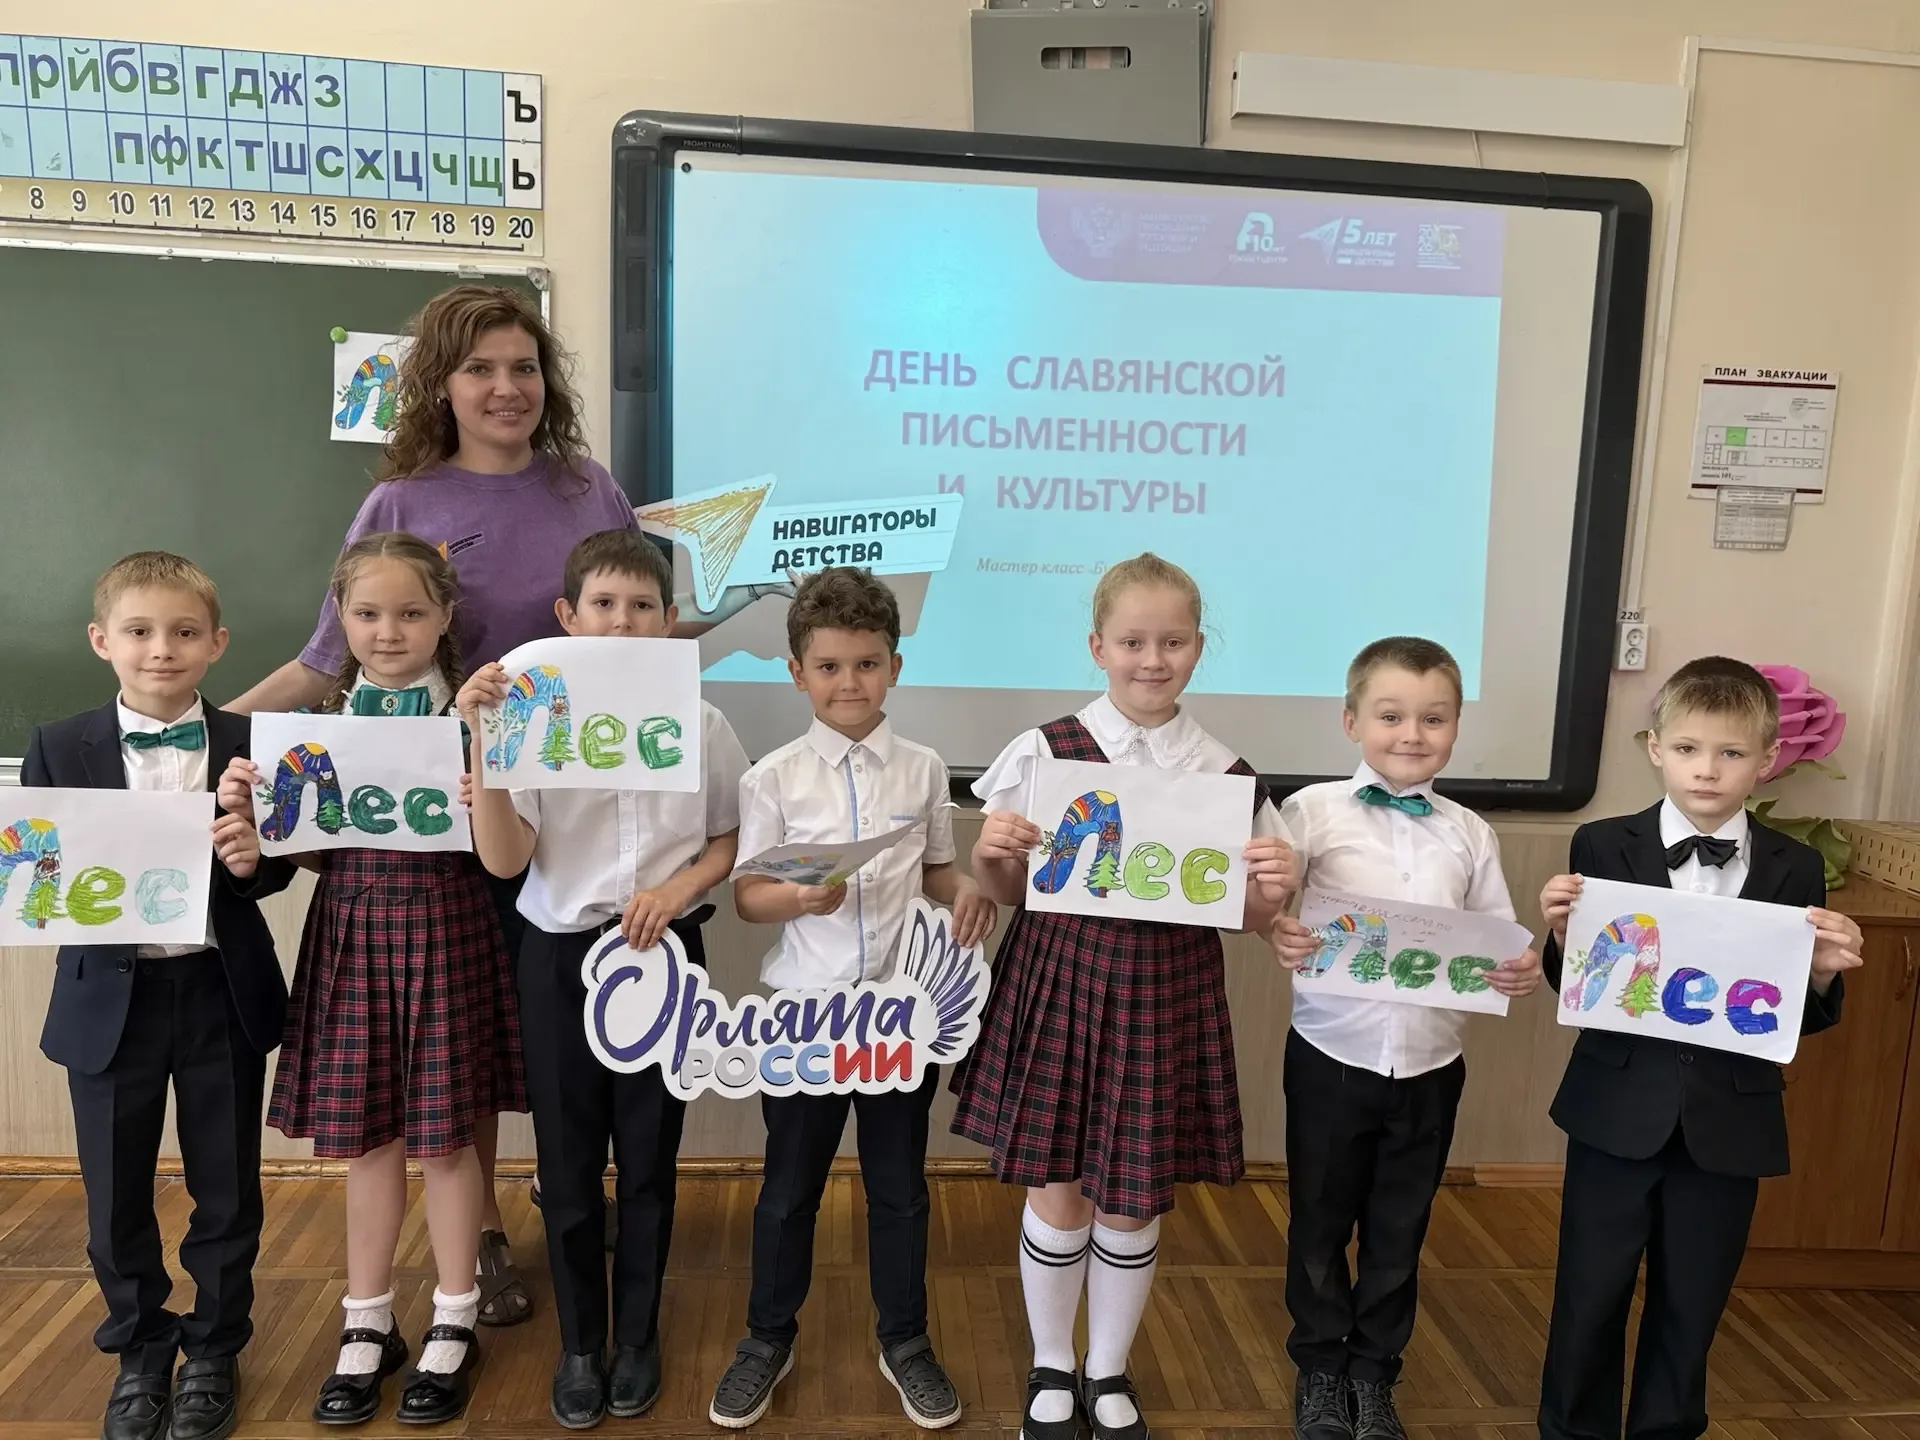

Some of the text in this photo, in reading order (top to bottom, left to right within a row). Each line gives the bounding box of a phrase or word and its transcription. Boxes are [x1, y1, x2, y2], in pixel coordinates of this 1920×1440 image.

[28, 55, 59, 99] р
[67, 48, 100, 92] й
[106, 48, 139, 93] б
[148, 62, 180, 95] в
[196, 66, 219, 99] г
[229, 68, 263, 109] д
[114, 132, 144, 164] п
[151, 125, 187, 175] ф
[683, 139, 733, 149] PROMETHEAN
[30, 187, 534, 239] 8 9 10 11 12 13 14 15 16 17 18 19 20
[1342, 219, 1396, 246] 5 ЛЕТ
[863, 349, 1286, 398] ДЕНЬ СЛАВЯНСКОЙ
[1714, 367, 1828, 382] ПЛАН ЭВАКУАЦИИ
[901, 411, 1247, 457] ПИСЬМЕННОСТИ
[937, 473, 1207, 515] И КУЛЬТУРЫ
[772, 507, 937, 541] НАВИГАТОРЫ
[771, 541, 883, 573] ДЕТСТВА
[976, 557, 1038, 576] Мастер
[1041, 563, 1084, 575] класс
[1620, 611, 1640, 620] 220
[594, 934, 917, 1075] Орлята
[679, 1041, 913, 1090] РОССИИ
